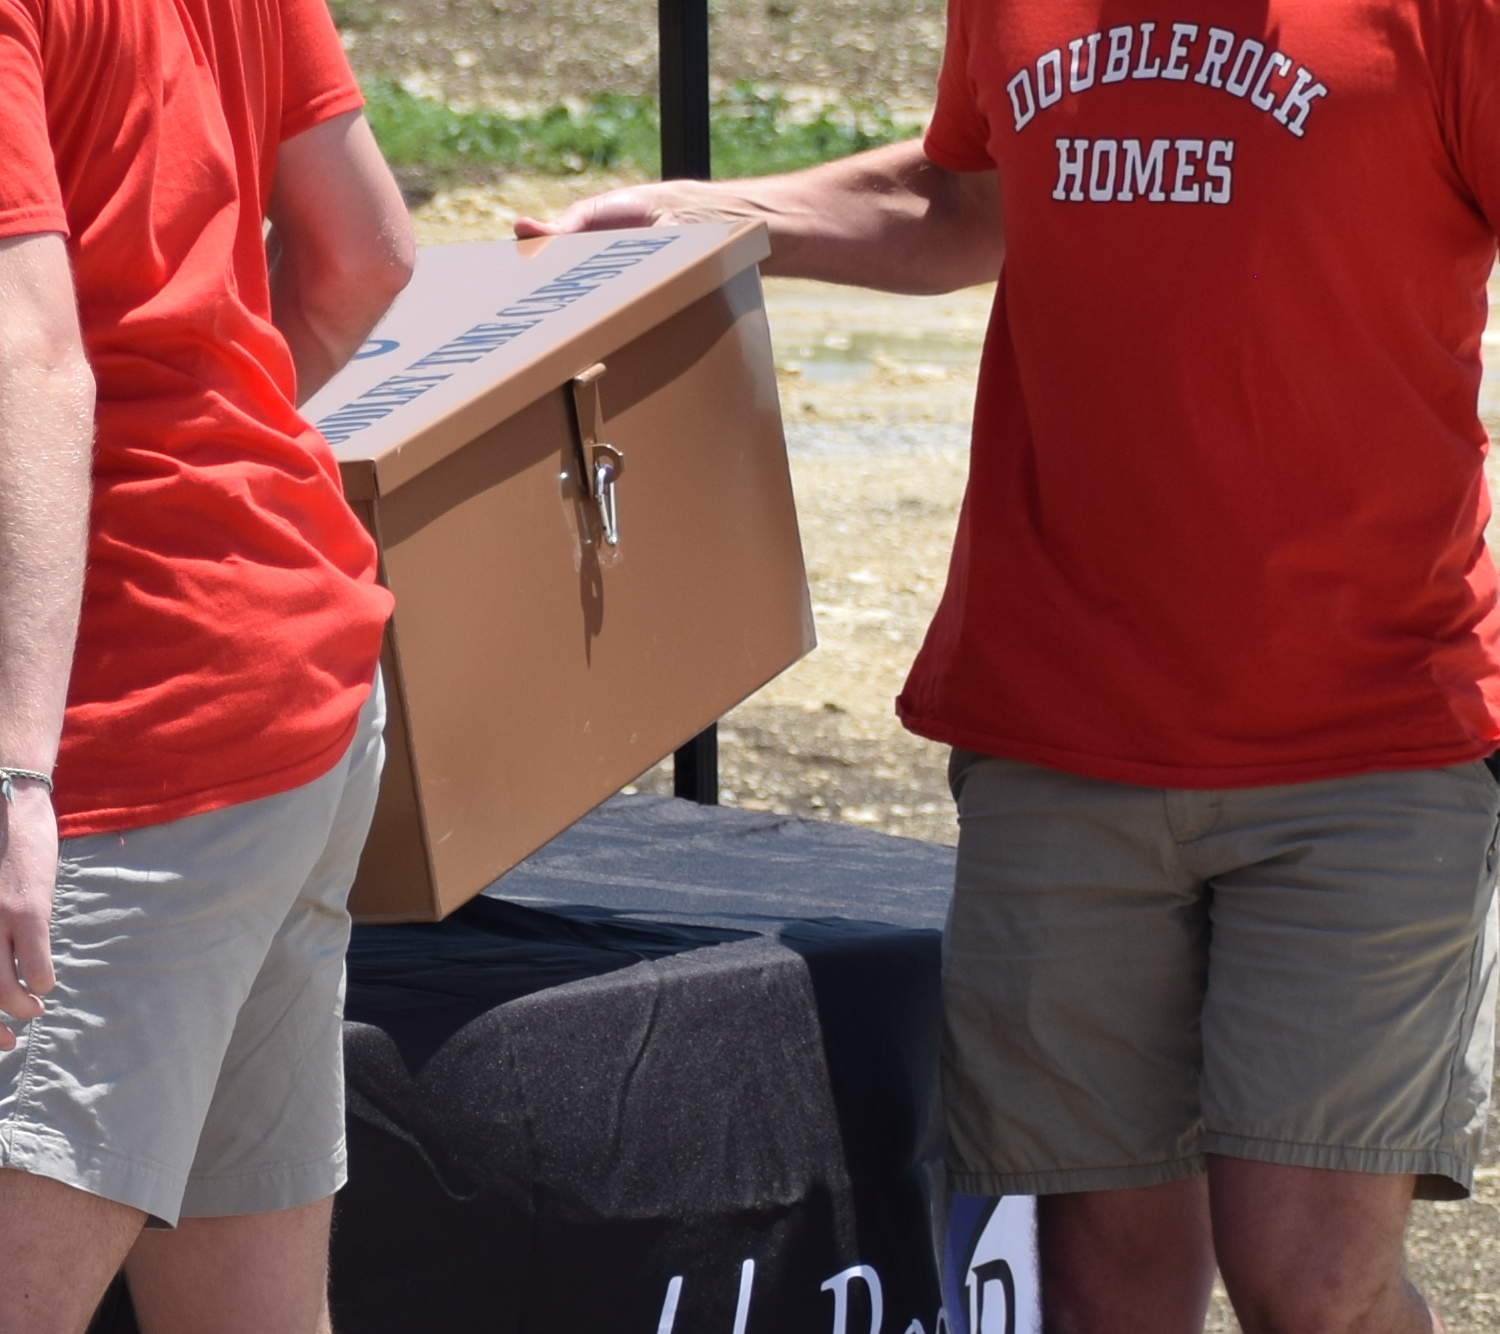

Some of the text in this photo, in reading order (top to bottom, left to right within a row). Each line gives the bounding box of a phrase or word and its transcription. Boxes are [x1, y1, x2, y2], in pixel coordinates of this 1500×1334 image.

[1006, 22, 1328, 137] DOUBLEROCK
[1052, 139, 1234, 205] HOMES
[404, 319, 544, 370] TIME
[495, 235, 681, 317] CAPSULE
